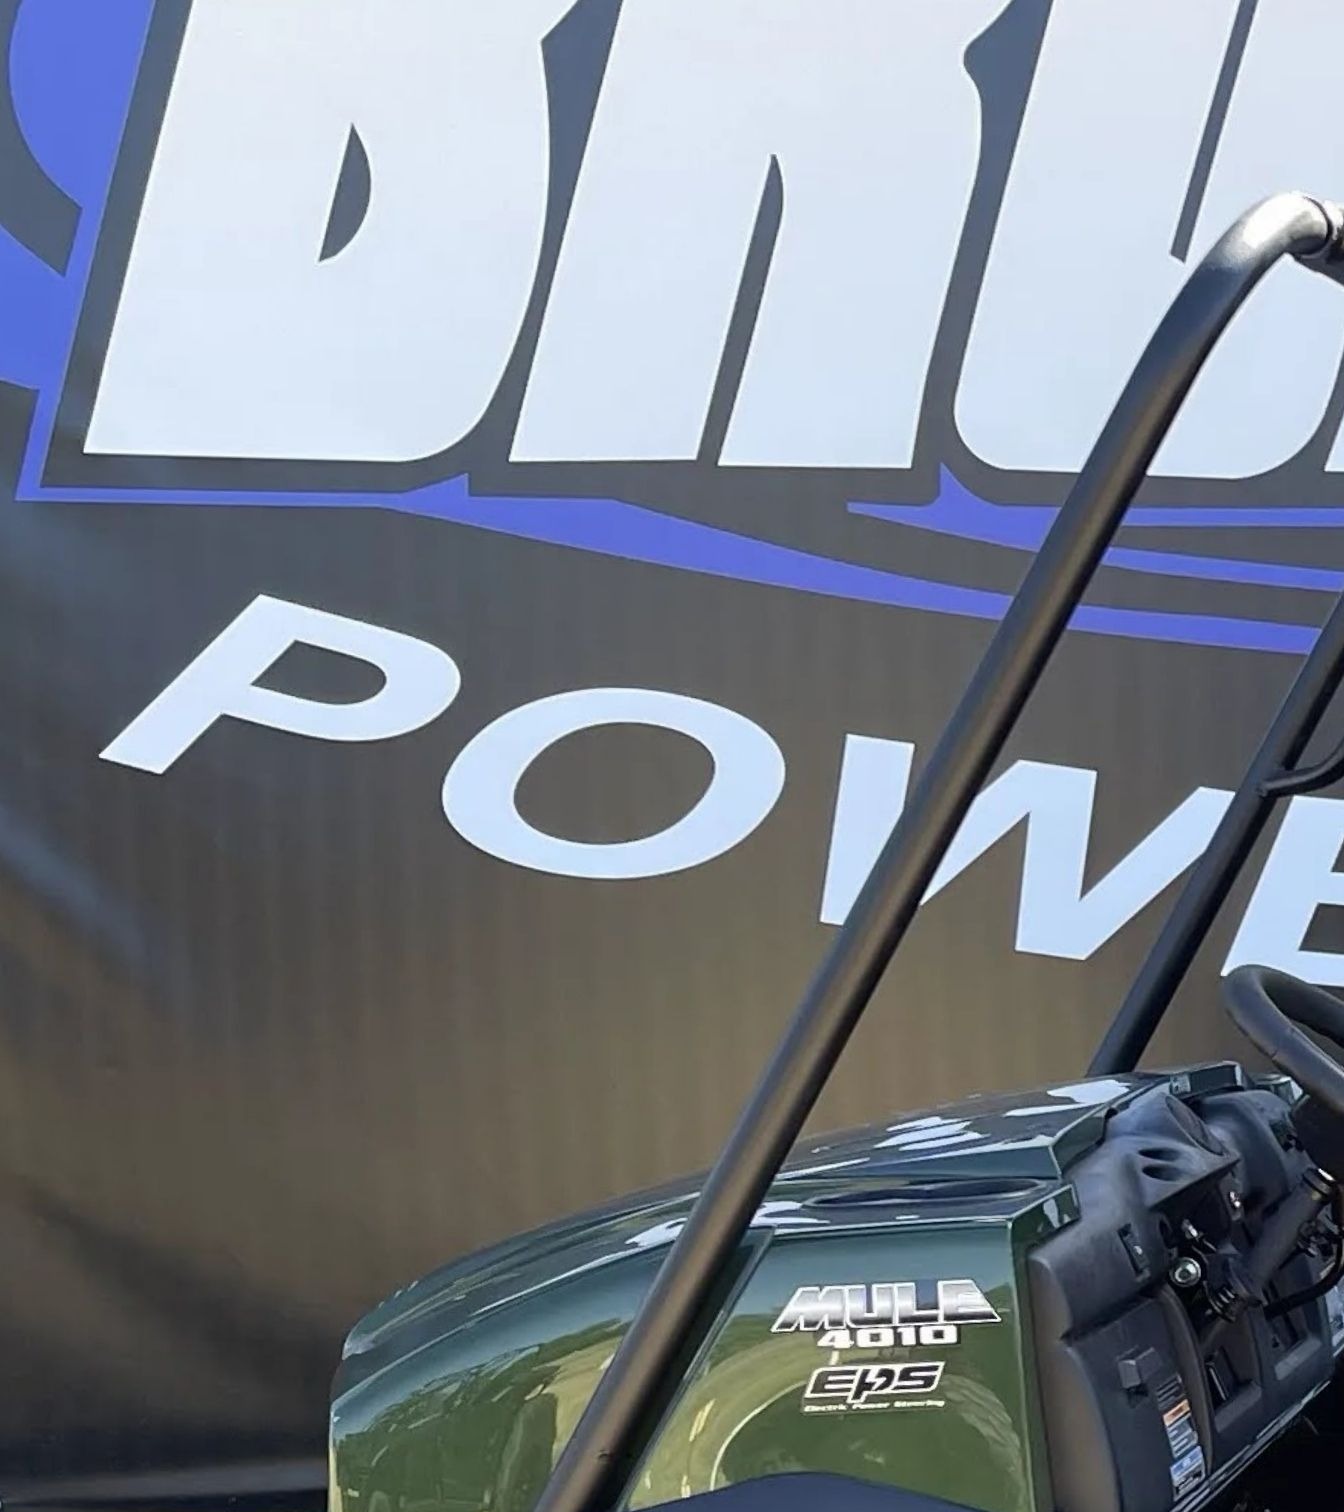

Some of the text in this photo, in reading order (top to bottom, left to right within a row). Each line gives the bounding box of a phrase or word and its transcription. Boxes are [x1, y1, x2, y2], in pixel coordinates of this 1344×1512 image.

[770, 1278, 1002, 1334] MULE
[816, 1324, 959, 1349] 4010
[804, 1361, 946, 1404] EPS
